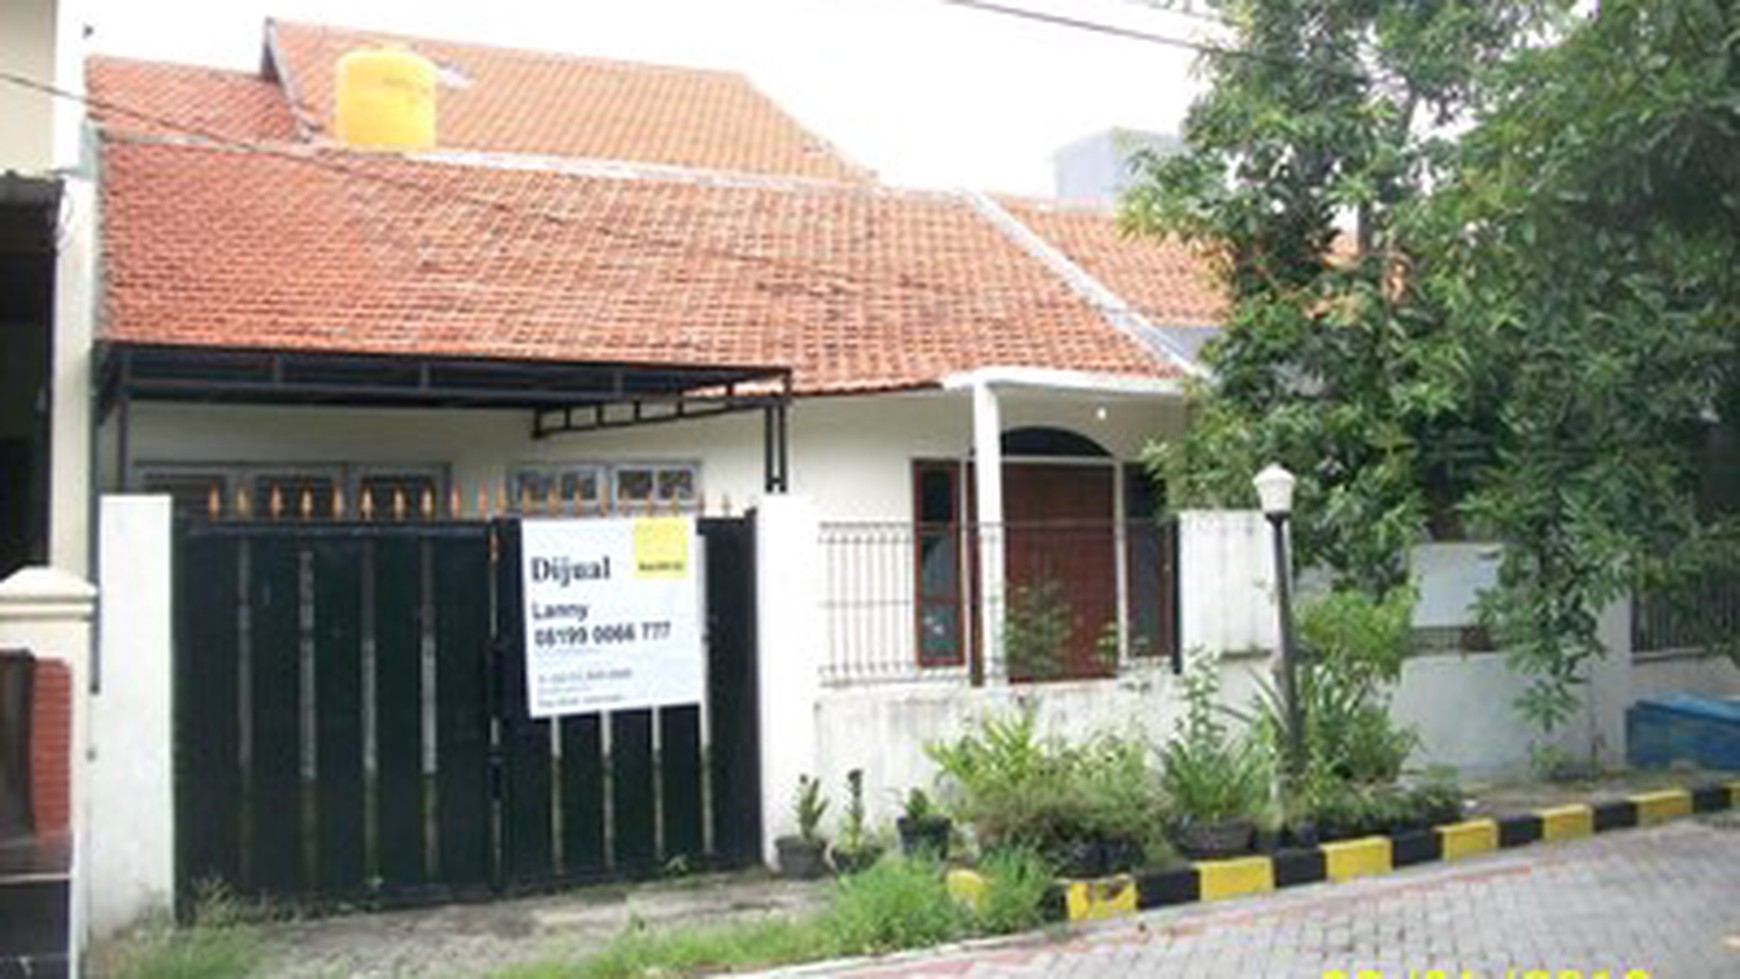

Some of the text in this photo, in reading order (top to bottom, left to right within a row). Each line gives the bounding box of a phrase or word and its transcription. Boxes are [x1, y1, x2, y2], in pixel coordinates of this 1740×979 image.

[531, 556, 611, 587] Dijual
[532, 601, 588, 622] Lanny
[641, 620, 671, 641] 777
